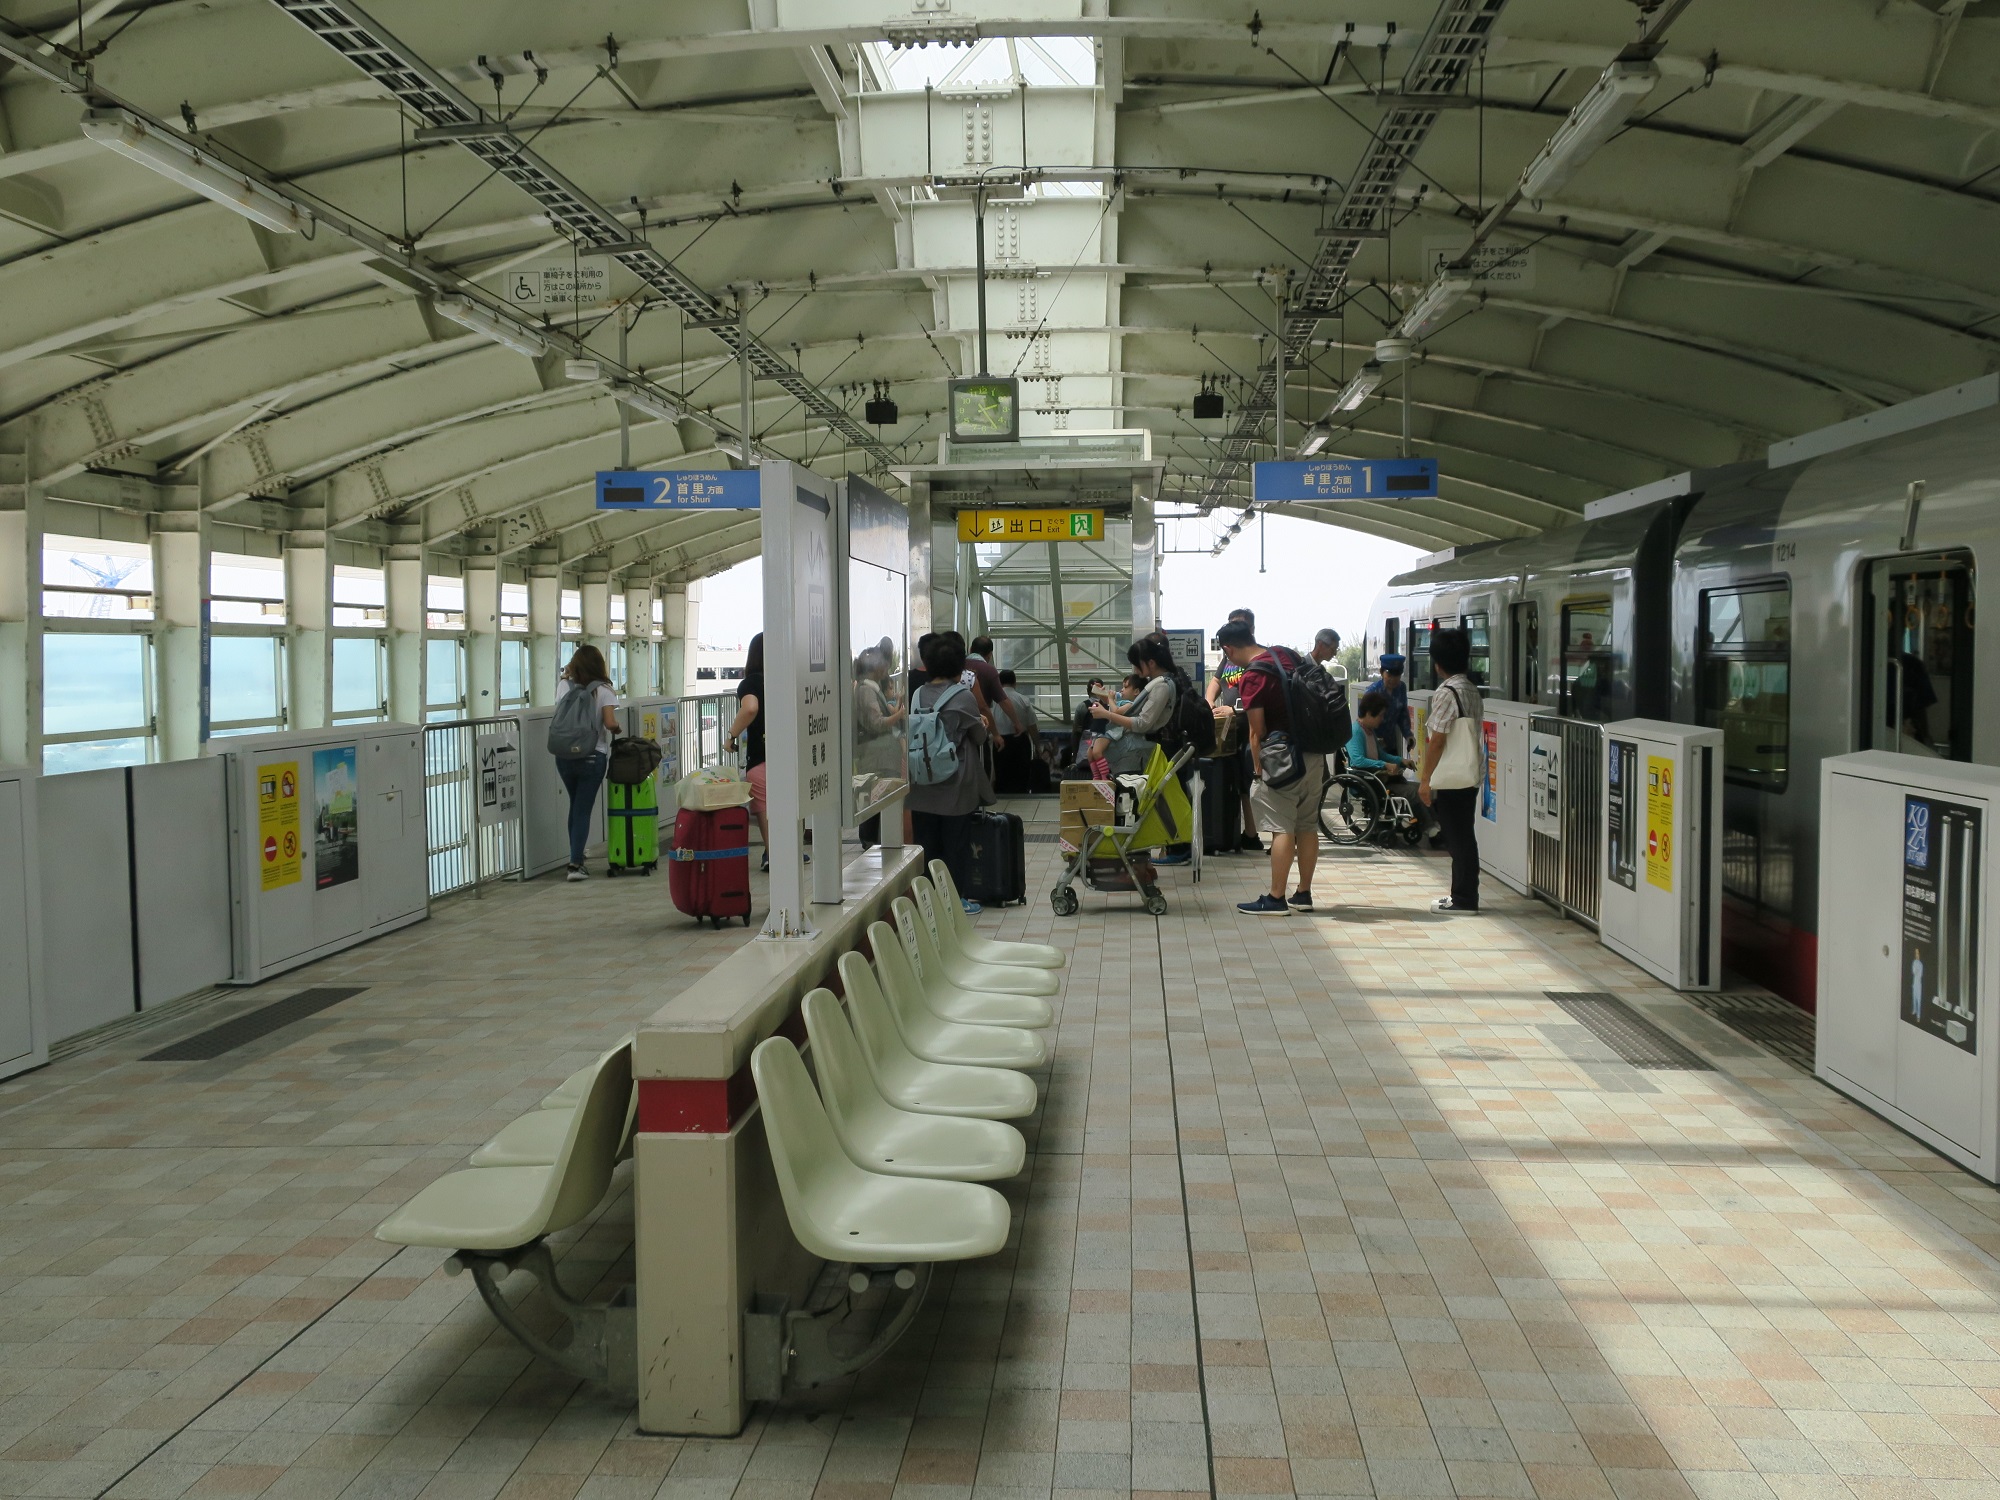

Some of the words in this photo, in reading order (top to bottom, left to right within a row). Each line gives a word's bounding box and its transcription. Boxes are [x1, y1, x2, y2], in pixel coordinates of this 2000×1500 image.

[1317, 485, 1329, 494] for
[1331, 485, 1352, 494] Shuri
[1362, 466, 1372, 493] 1
[653, 477, 672, 504] 2
[677, 495, 688, 503] for
[690, 495, 711, 503] Shuri
[1010, 519, 1042, 533] 出口
[1776, 542, 1796, 562] 1214
[804, 683, 831, 704] エレベーター
[808, 713, 829, 736] Elevator
[497, 773, 517, 784] Elevator
[1532, 777, 1547, 790] Elevator
[1908, 804, 1929, 828] KO
[1907, 827, 1927, 851] ZA
